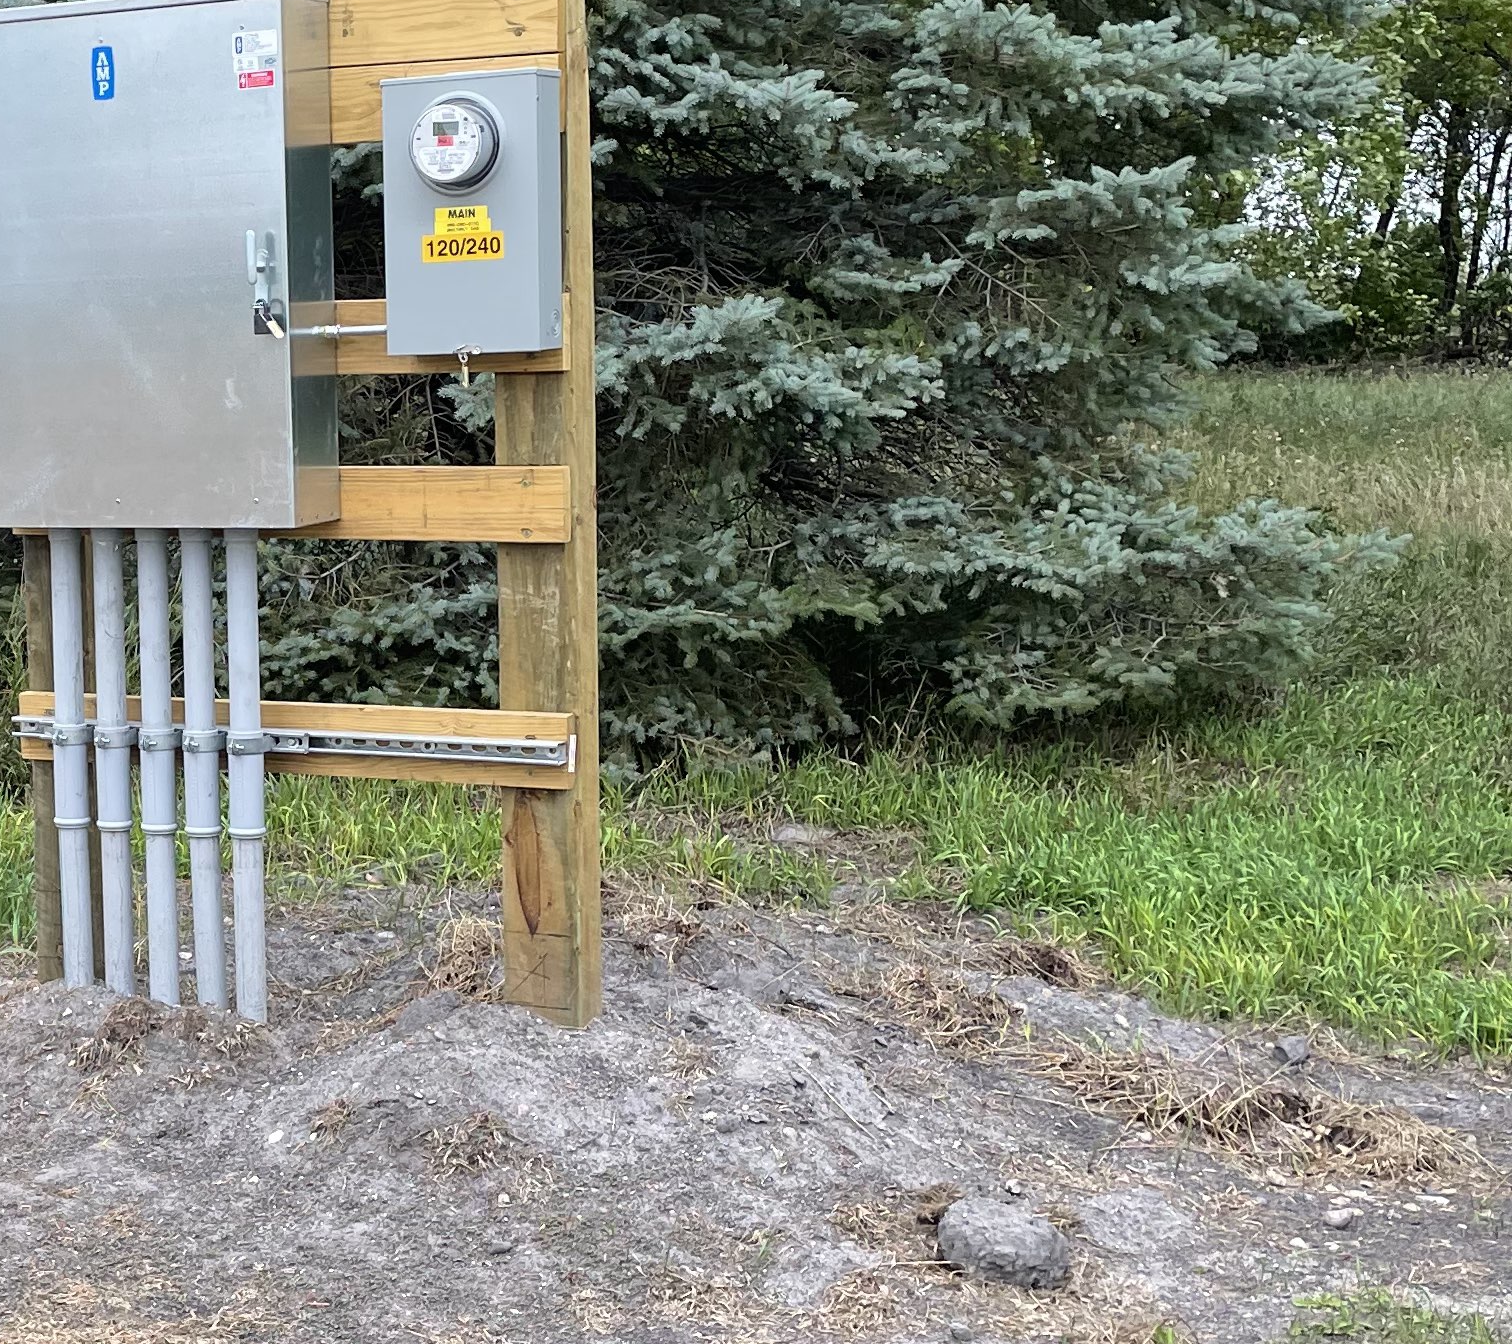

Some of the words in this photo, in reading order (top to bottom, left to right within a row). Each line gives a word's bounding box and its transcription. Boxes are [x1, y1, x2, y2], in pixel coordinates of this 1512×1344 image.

[96, 51, 110, 96] AMP
[448, 208, 476, 218] MAIN
[426, 237, 501, 257] 120/240
